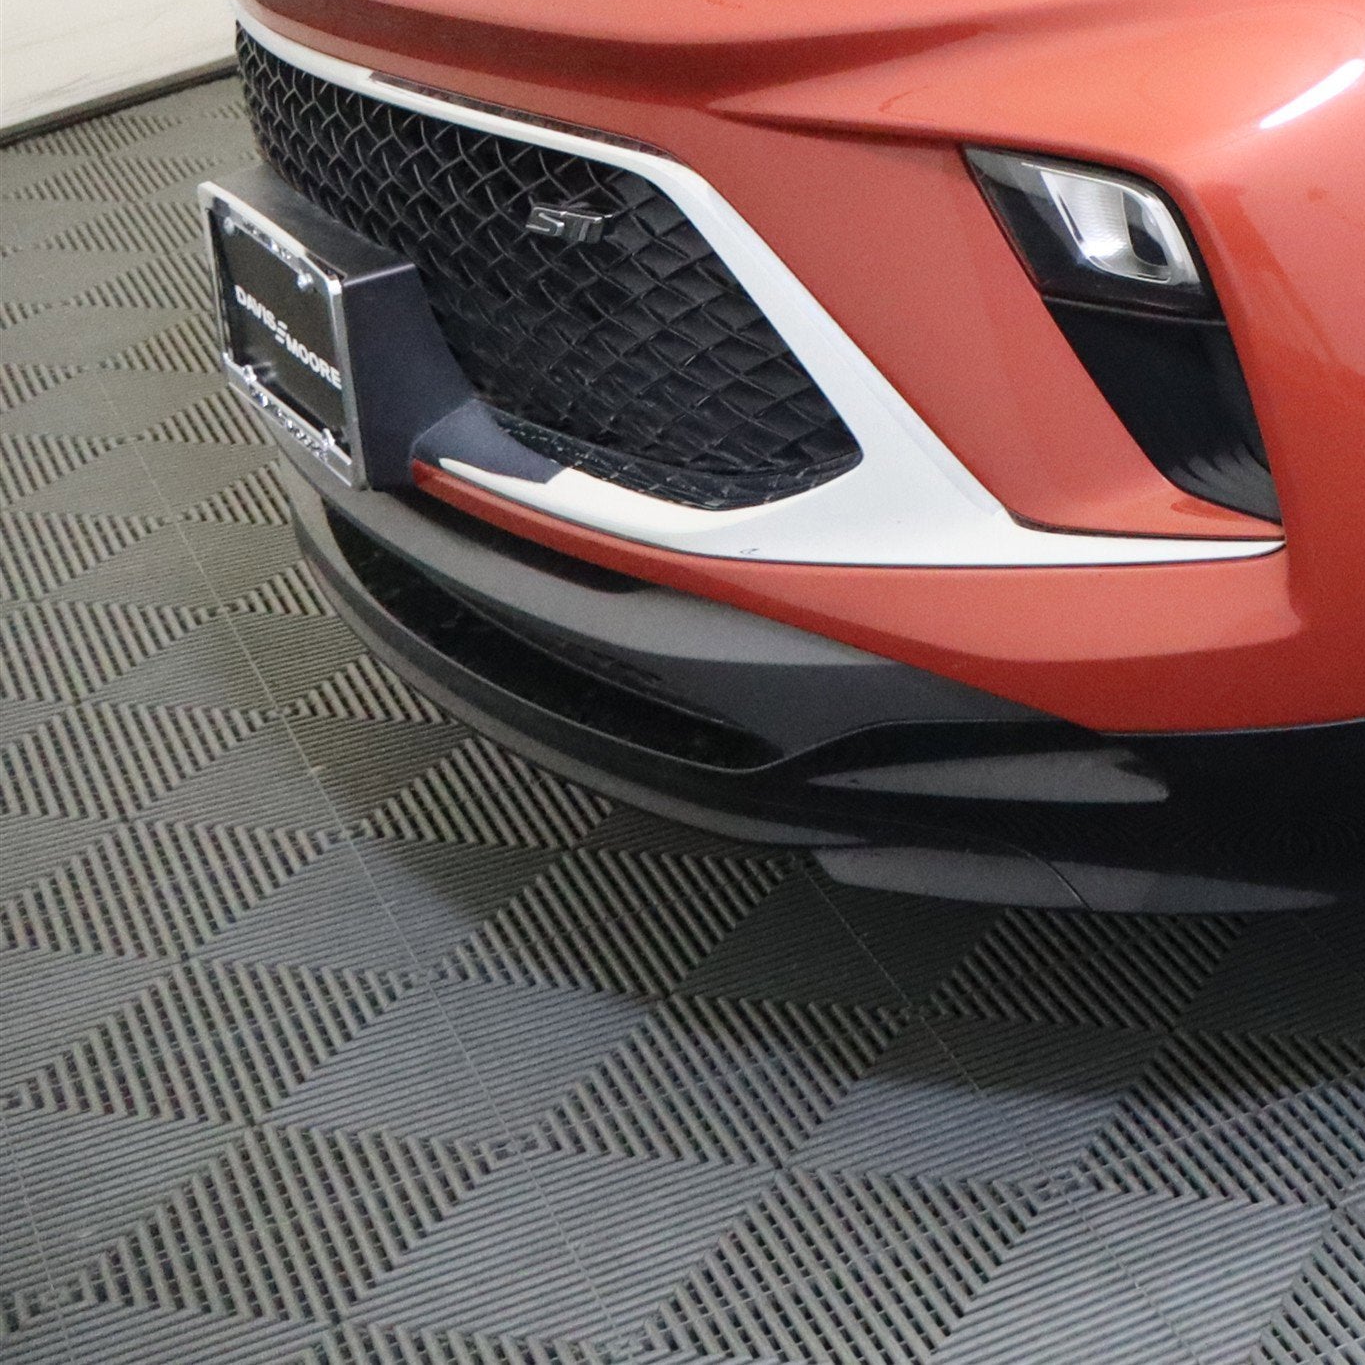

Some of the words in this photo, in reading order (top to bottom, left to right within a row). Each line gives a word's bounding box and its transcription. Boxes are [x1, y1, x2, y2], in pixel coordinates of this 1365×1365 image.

[526, 208, 603, 243] ST
[234, 285, 279, 332] DAVIS
[285, 337, 342, 391] MOORE
